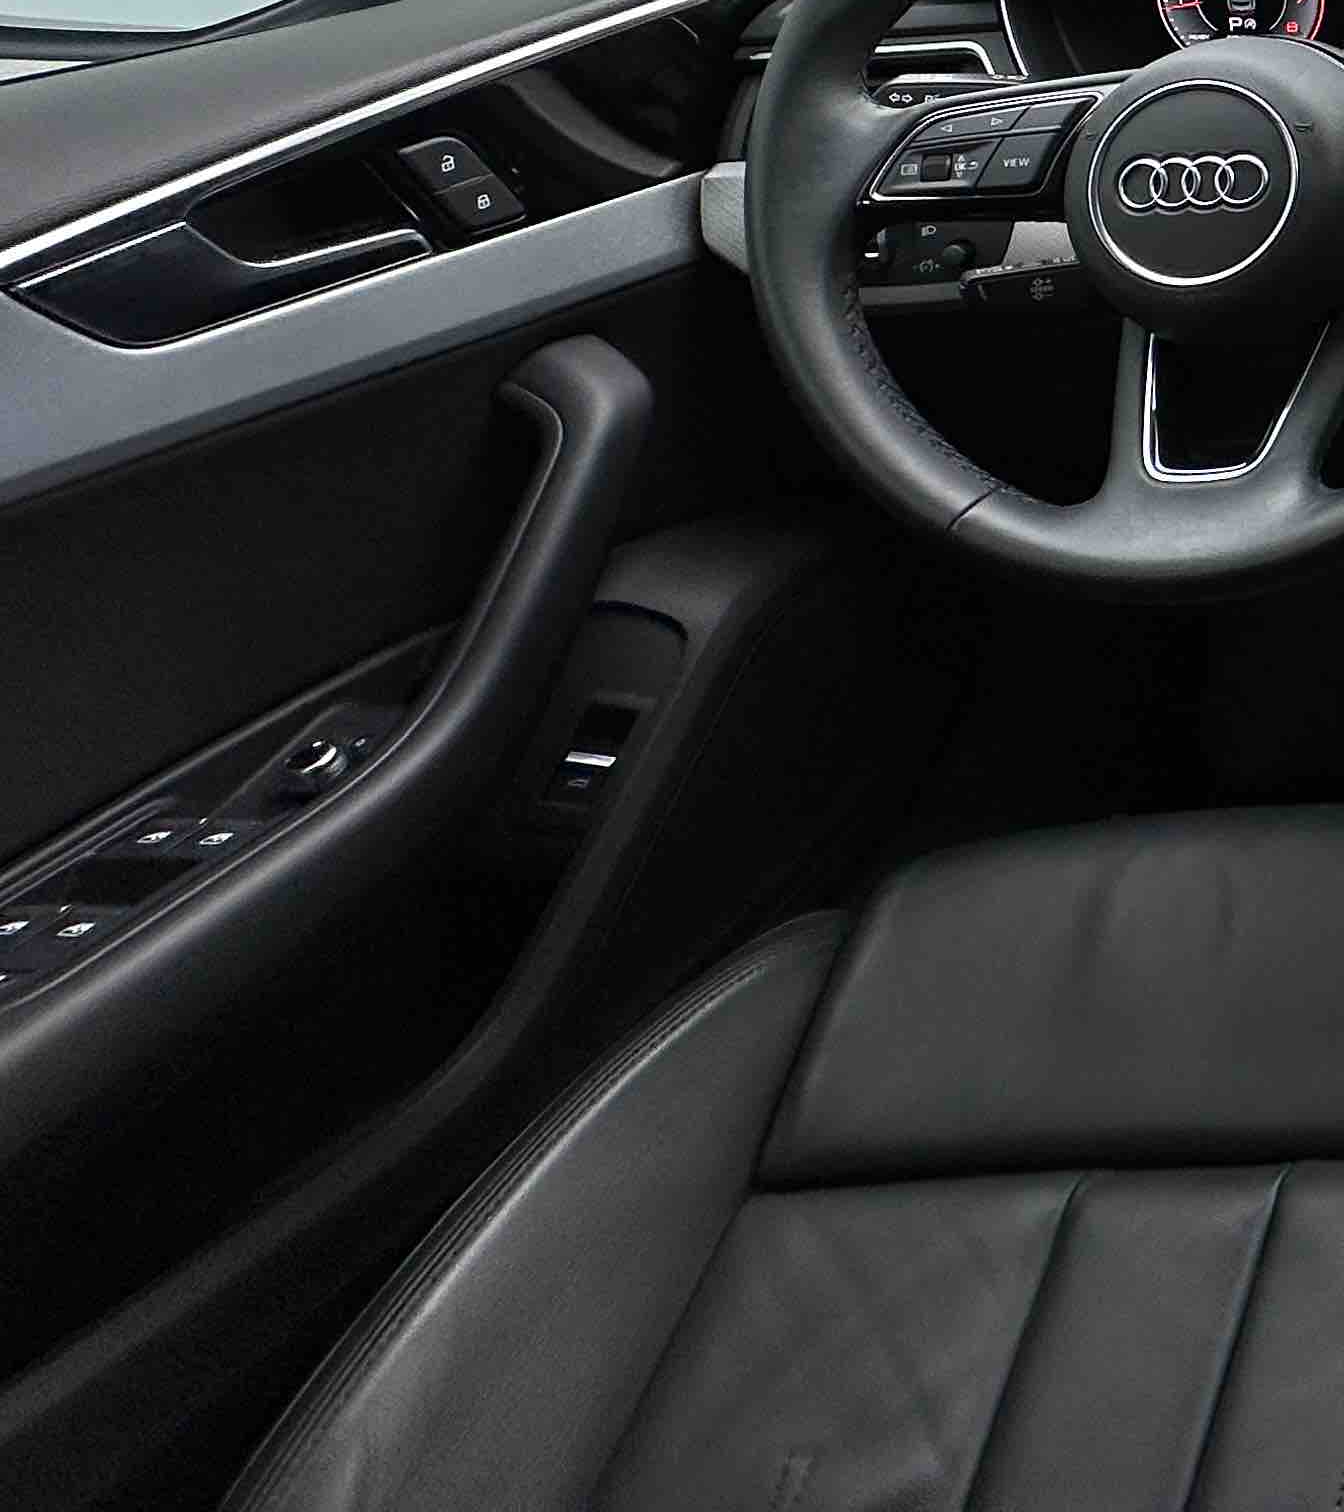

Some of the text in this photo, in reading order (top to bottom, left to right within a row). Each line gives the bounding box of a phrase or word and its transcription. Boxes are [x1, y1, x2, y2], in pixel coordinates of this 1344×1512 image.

[1229, 18, 1243, 32] P
[1286, 22, 1299, 33] 8
[1003, 157, 1030, 168] VIEW
